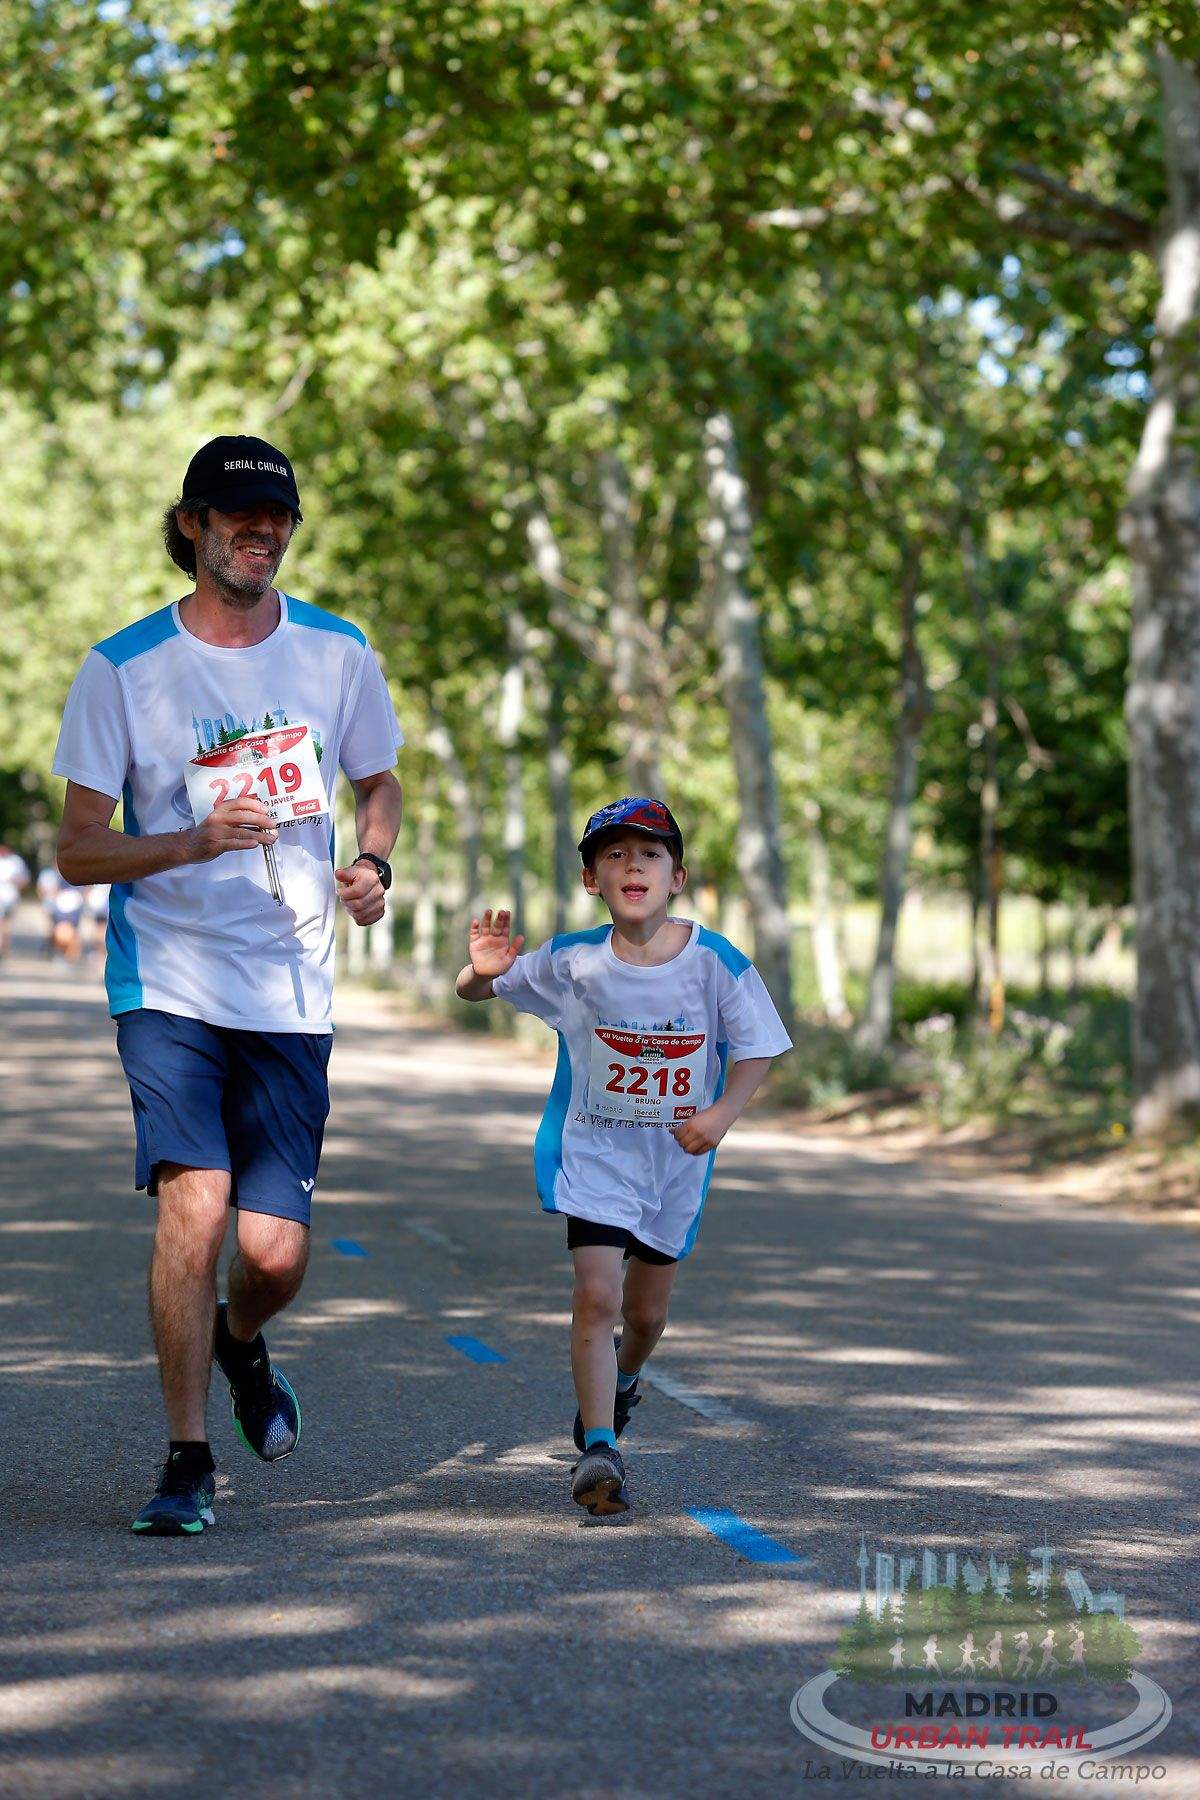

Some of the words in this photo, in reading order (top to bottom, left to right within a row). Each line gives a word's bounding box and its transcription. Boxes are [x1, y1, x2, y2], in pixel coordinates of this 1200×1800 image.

[224, 459, 256, 471] SERIAL
[246, 739, 263, 747] Casa
[209, 762, 302, 809] 2219
[270, 795, 295, 807] JAVIER
[612, 1033, 633, 1043] Vuelta
[641, 1036, 649, 1044] la
[681, 1038, 702, 1046] Campo
[605, 1063, 691, 1097] 2218
[601, 1105, 622, 1113] MADRID
[574, 1112, 586, 1123] La
